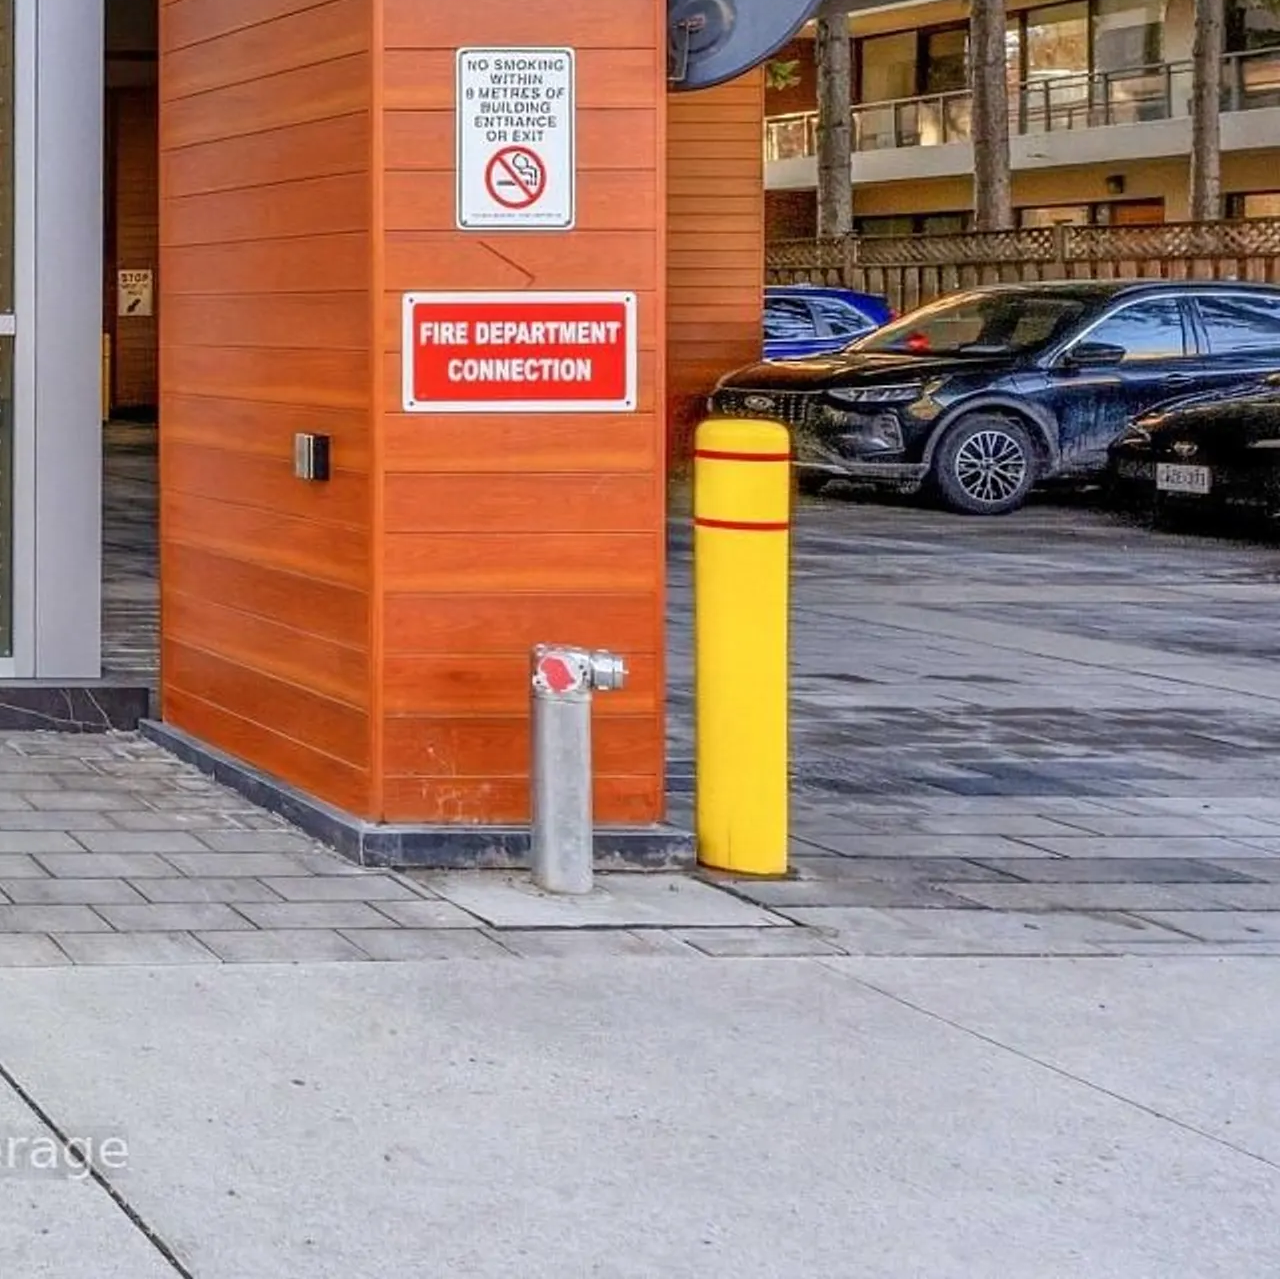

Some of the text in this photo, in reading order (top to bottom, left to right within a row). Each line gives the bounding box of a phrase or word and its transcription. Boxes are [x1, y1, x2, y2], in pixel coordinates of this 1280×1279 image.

[467, 59, 564, 72] NO SMOKING
[490, 73, 543, 85] WITHIN
[478, 87, 541, 100] METRES
[546, 87, 565, 100] OF
[480, 101, 552, 114] BUILDING
[474, 115, 557, 128] ENTRANCE
[486, 130, 544, 142] OR EXIT
[420, 321, 622, 345] FIRE DEPARTMENT
[447, 358, 592, 382] CONNECTION
